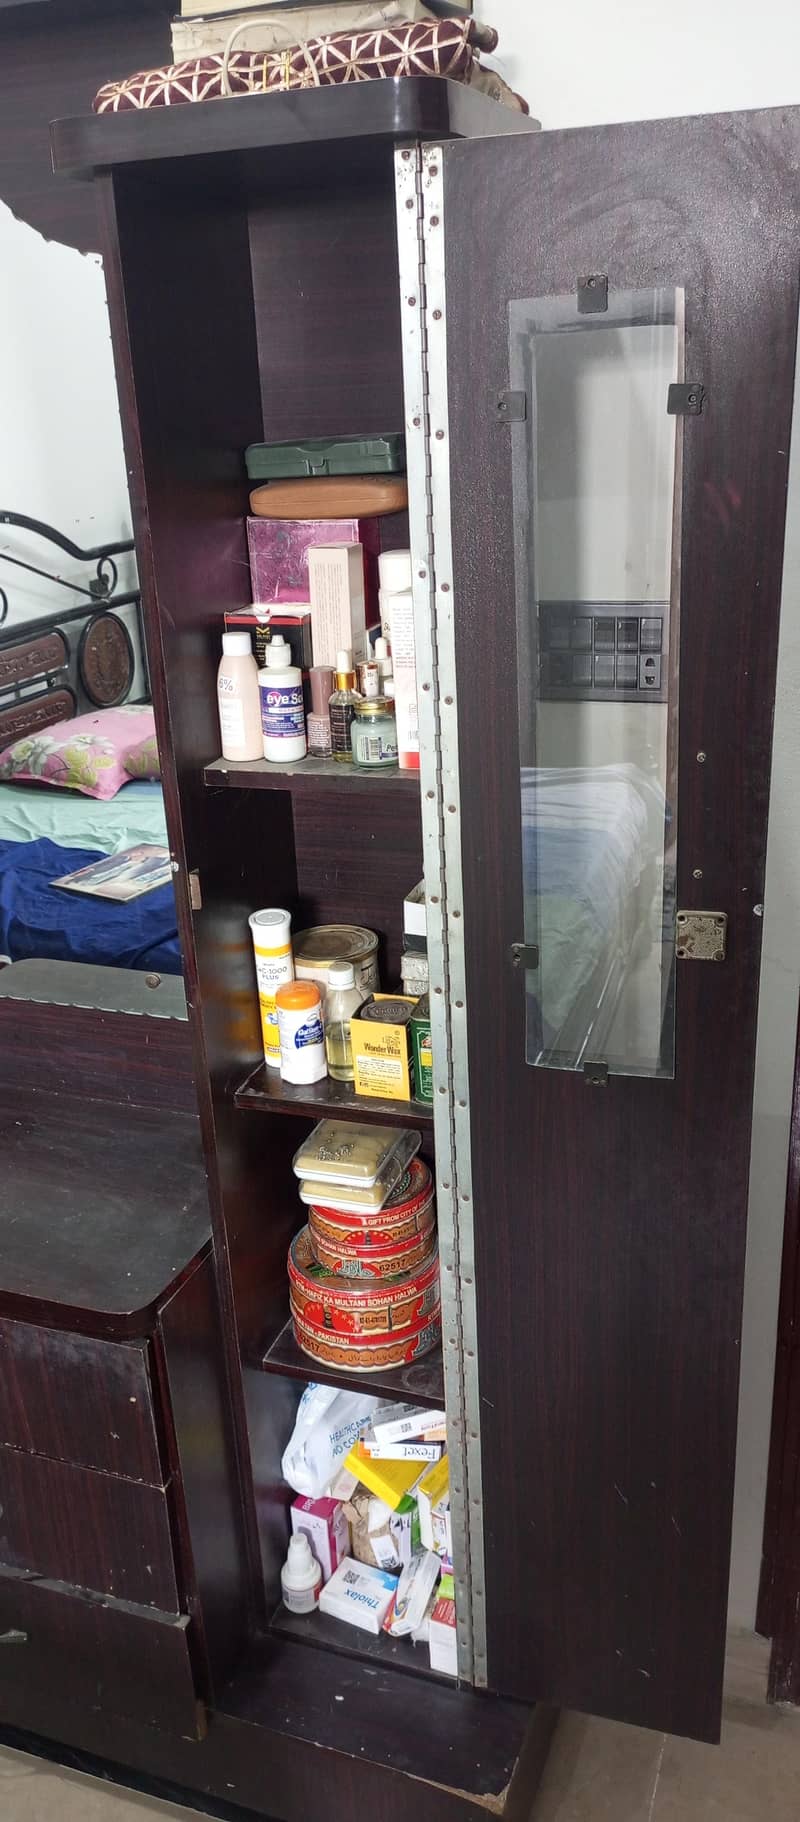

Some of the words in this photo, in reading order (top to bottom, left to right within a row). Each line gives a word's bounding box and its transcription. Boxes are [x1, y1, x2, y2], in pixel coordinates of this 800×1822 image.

[368, 1218, 382, 1226] GIFT
[382, 1213, 400, 1224] FROM
[335, 1298, 366, 1308] MULTANI
[343, 1588, 381, 1611] Thiolax
